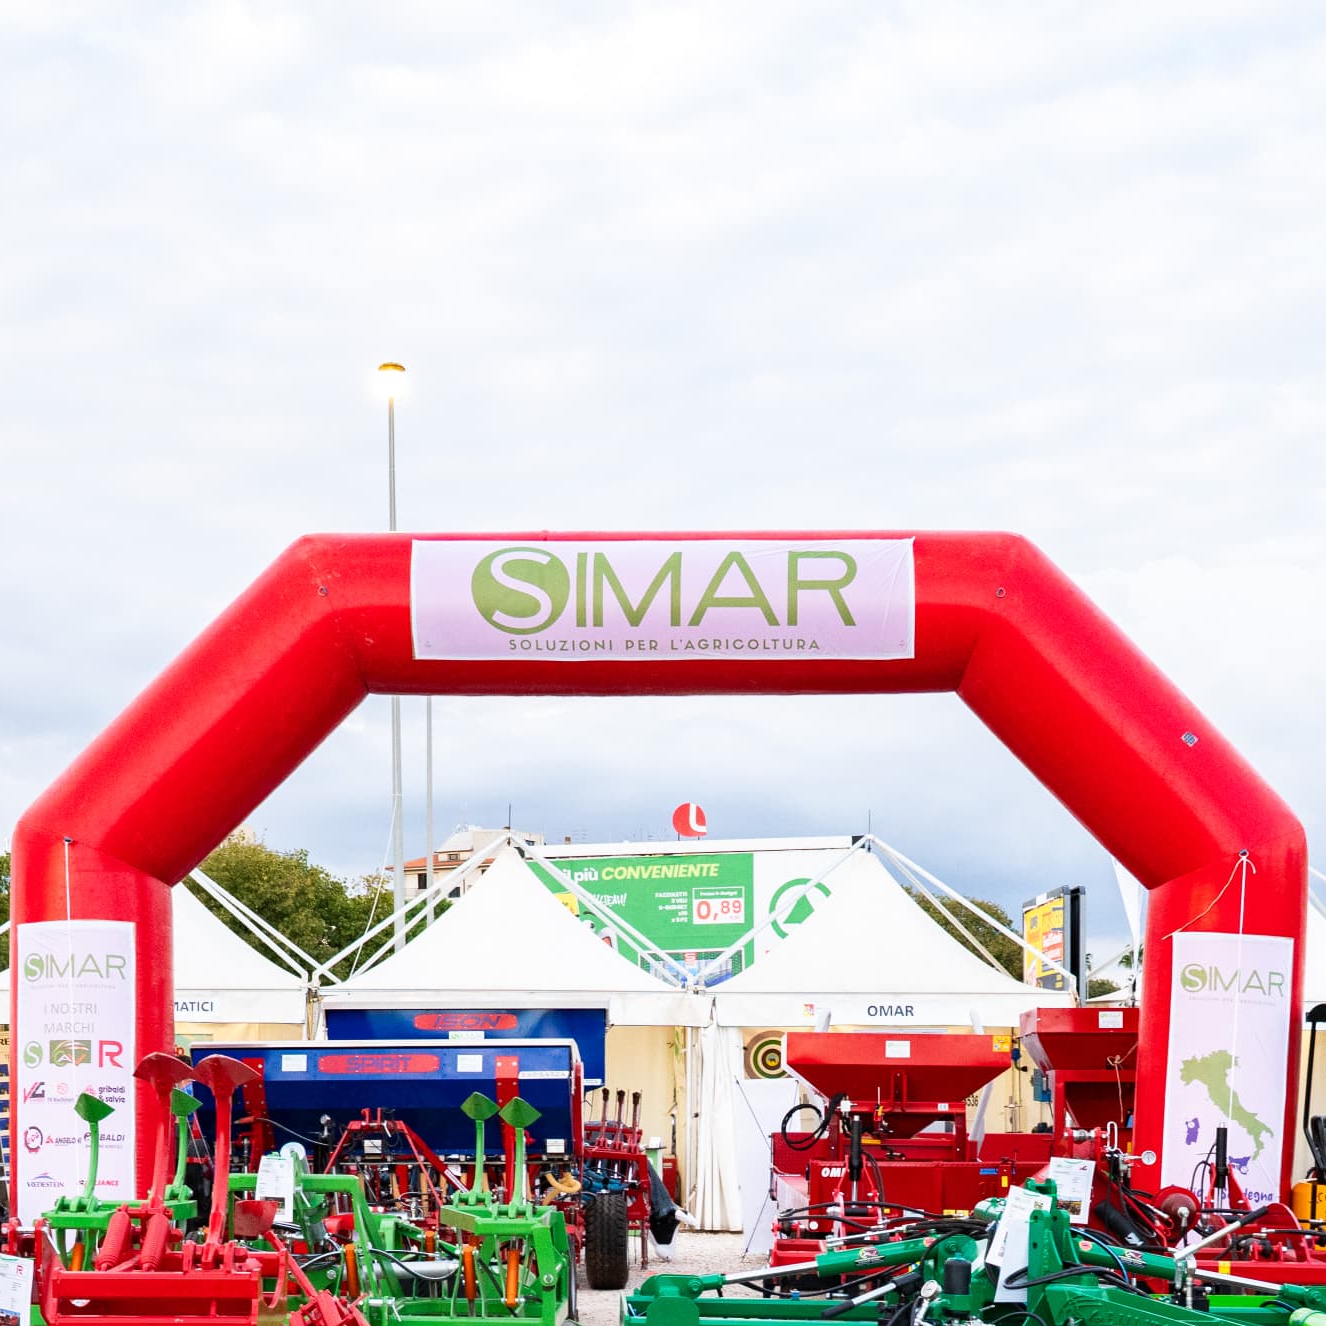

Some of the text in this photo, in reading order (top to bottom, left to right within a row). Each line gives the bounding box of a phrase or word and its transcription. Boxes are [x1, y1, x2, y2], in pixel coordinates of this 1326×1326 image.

[471, 546, 857, 636] SIMAR
[509, 638, 820, 652] SOLUZIONI PER L'AGRICOLTURA
[575, 866, 598, 883] più
[601, 863, 720, 881] CONVENIENTE
[24, 952, 126, 982] SIMAR
[1180, 963, 1285, 997] SIMAR
[867, 1005, 915, 1017] OMAR
[345, 1056, 413, 1072] SPIRIT
